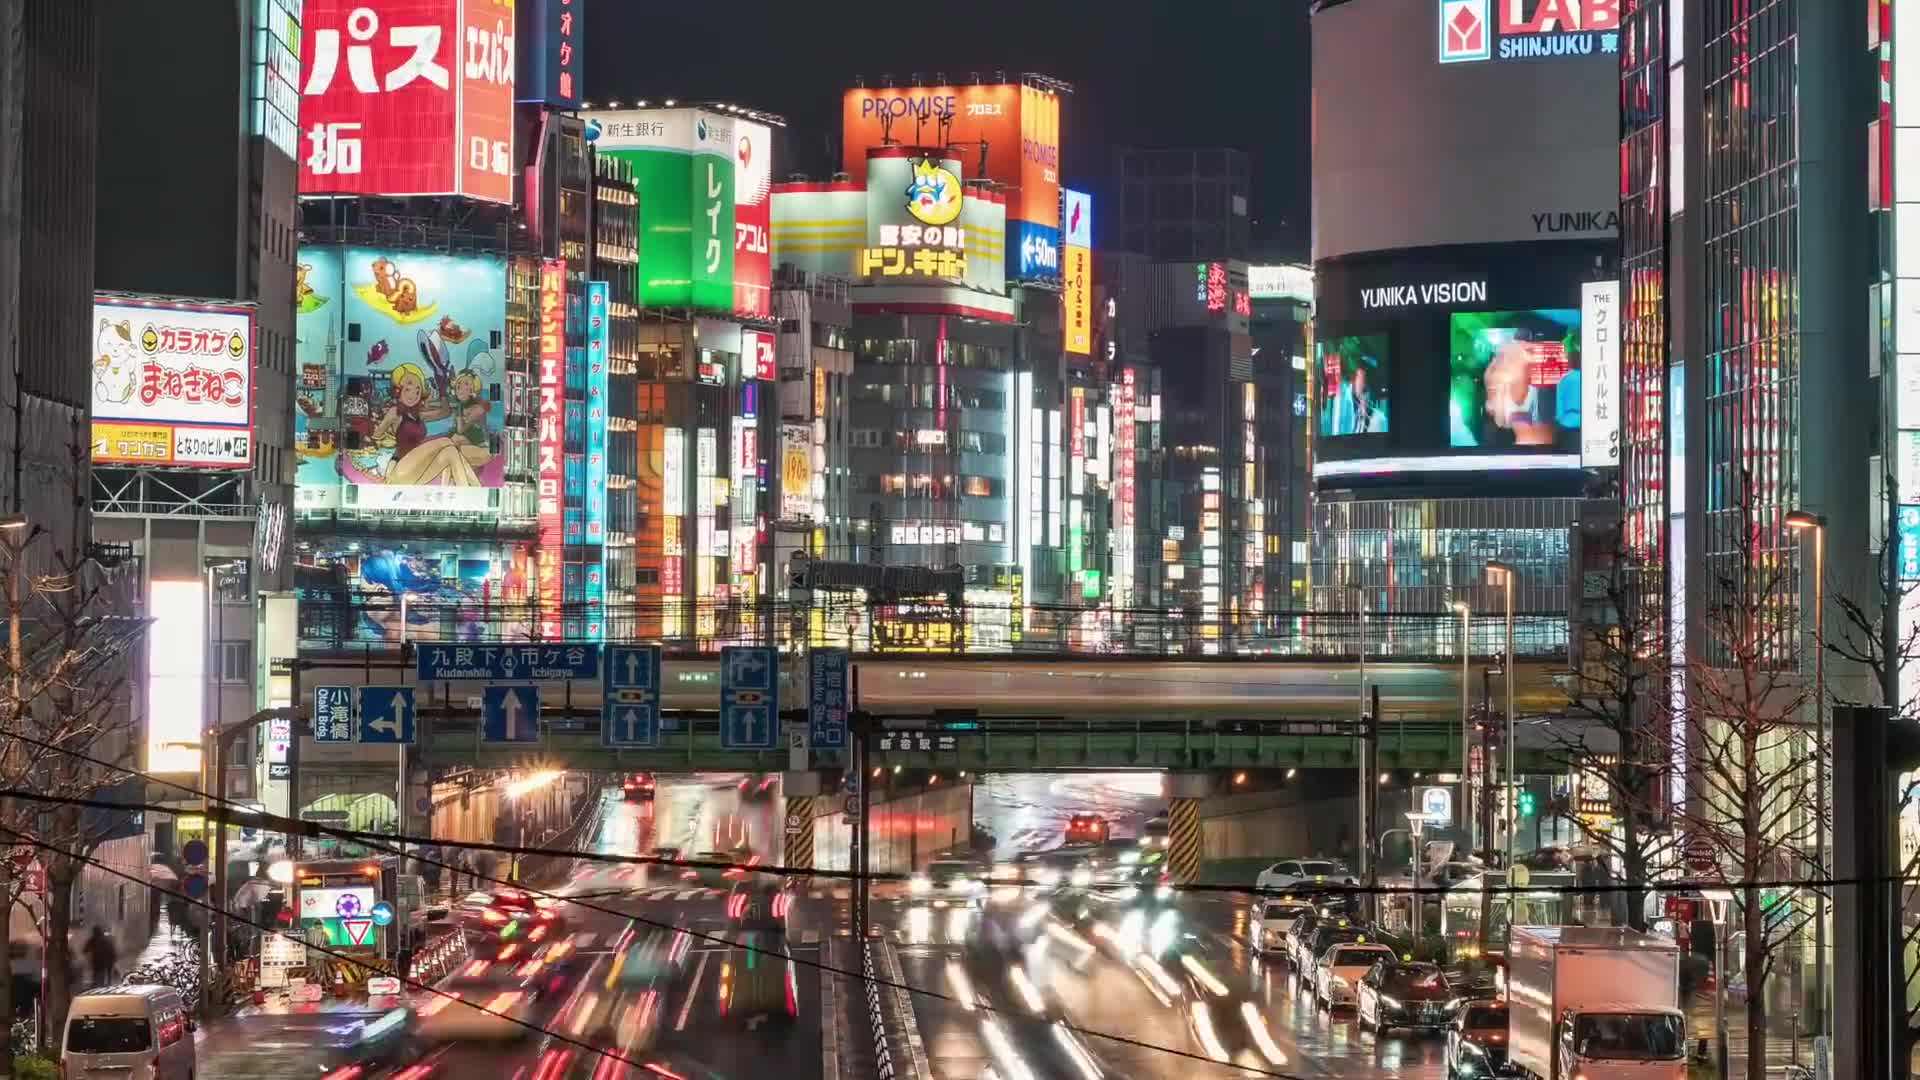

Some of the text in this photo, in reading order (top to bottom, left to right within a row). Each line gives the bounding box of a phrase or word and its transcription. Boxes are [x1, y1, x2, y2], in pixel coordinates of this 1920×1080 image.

[1499, 34, 1592, 58] SHINJUKU
[861, 96, 956, 118] PROMISE
[607, 122, 664, 139] 新生銀行
[705, 163, 722, 273] レイク
[735, 222, 768, 253] アコム
[1361, 281, 1487, 308] YUNIKA VISION
[160, 328, 226, 354] カラオケ
[139, 361, 244, 405] まねきねこ
[177, 437, 222, 459] となりのビル
[432, 647, 497, 666] 九段下
[531, 668, 574, 678] Ichigaya
